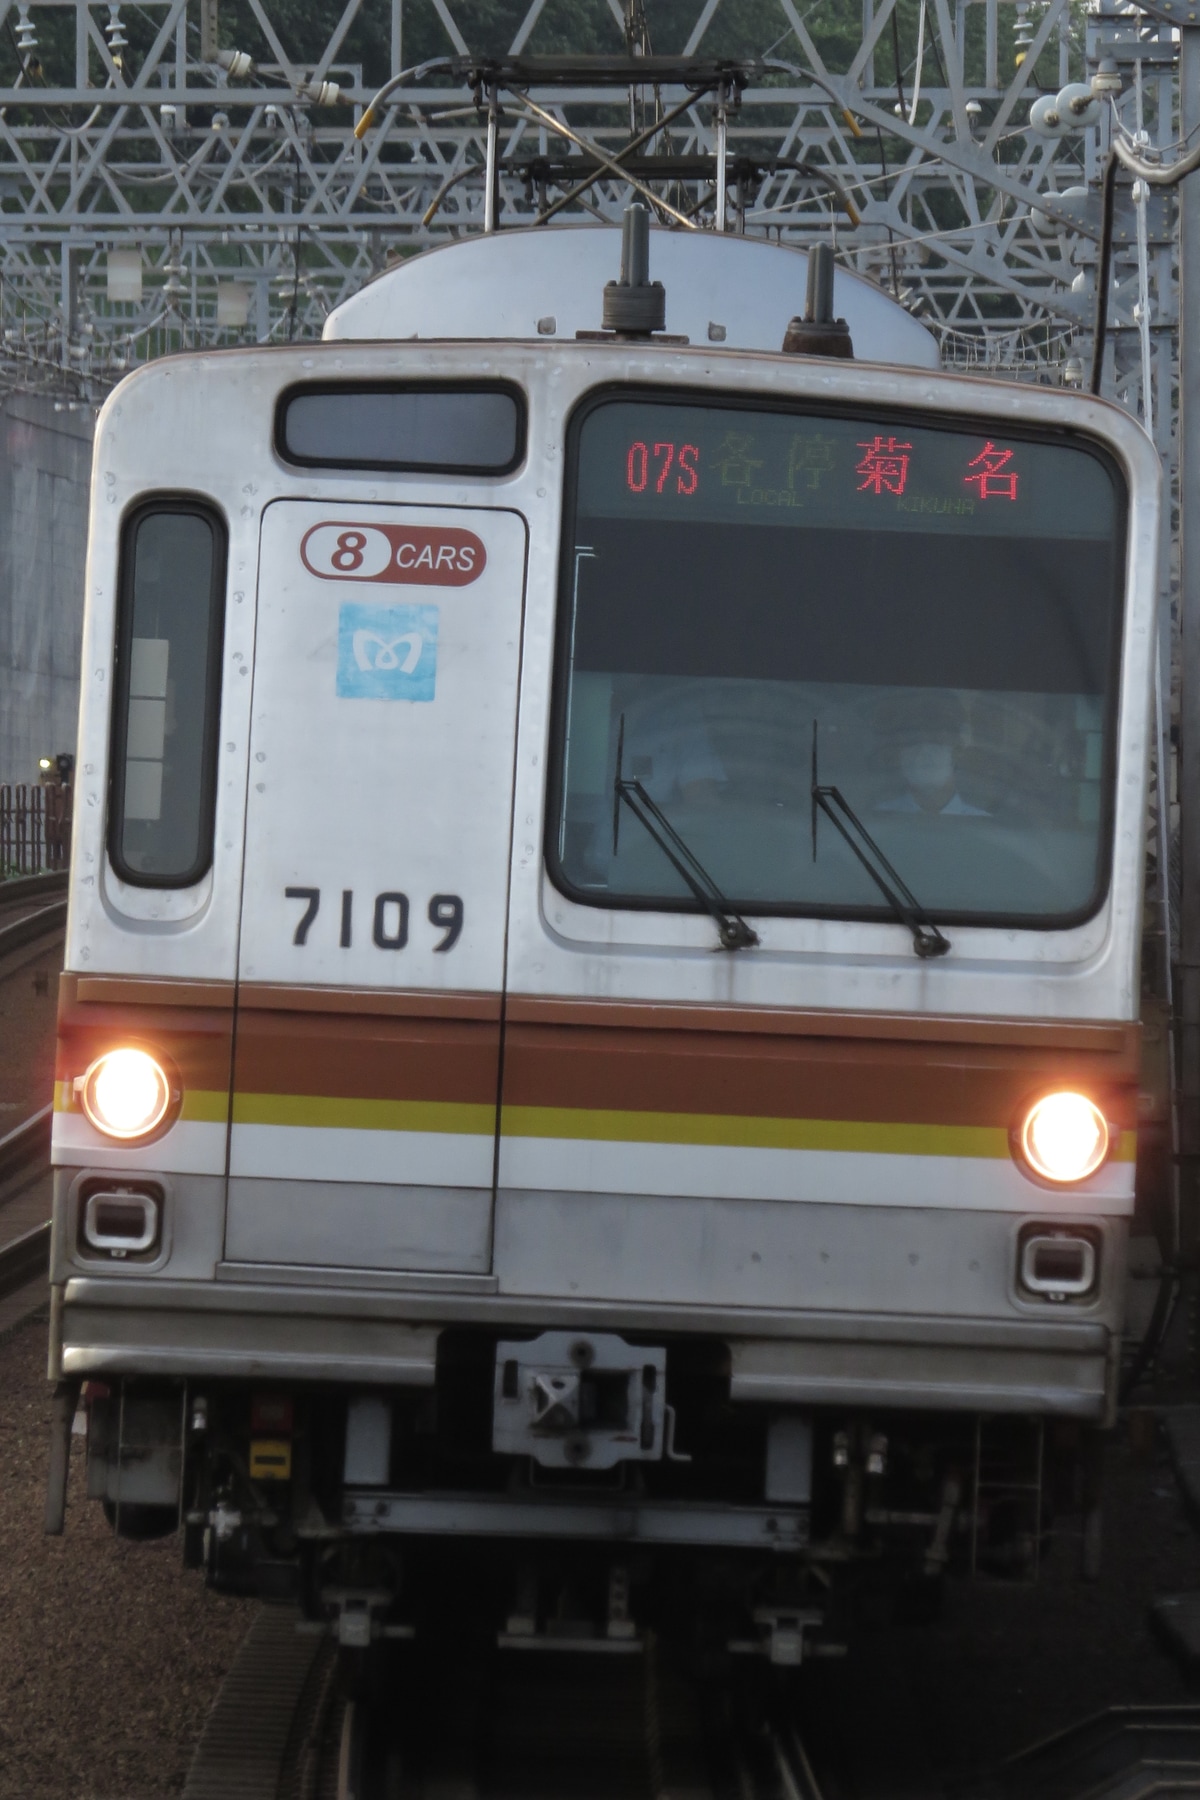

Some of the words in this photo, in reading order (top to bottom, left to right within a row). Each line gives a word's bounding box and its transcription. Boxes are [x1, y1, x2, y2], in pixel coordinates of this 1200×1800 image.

[626, 441, 699, 494] 07S
[856, 436, 1019, 501] 菊名
[331, 531, 368, 571] 8
[396, 543, 476, 572] CARS
[285, 887, 464, 954] 7109
